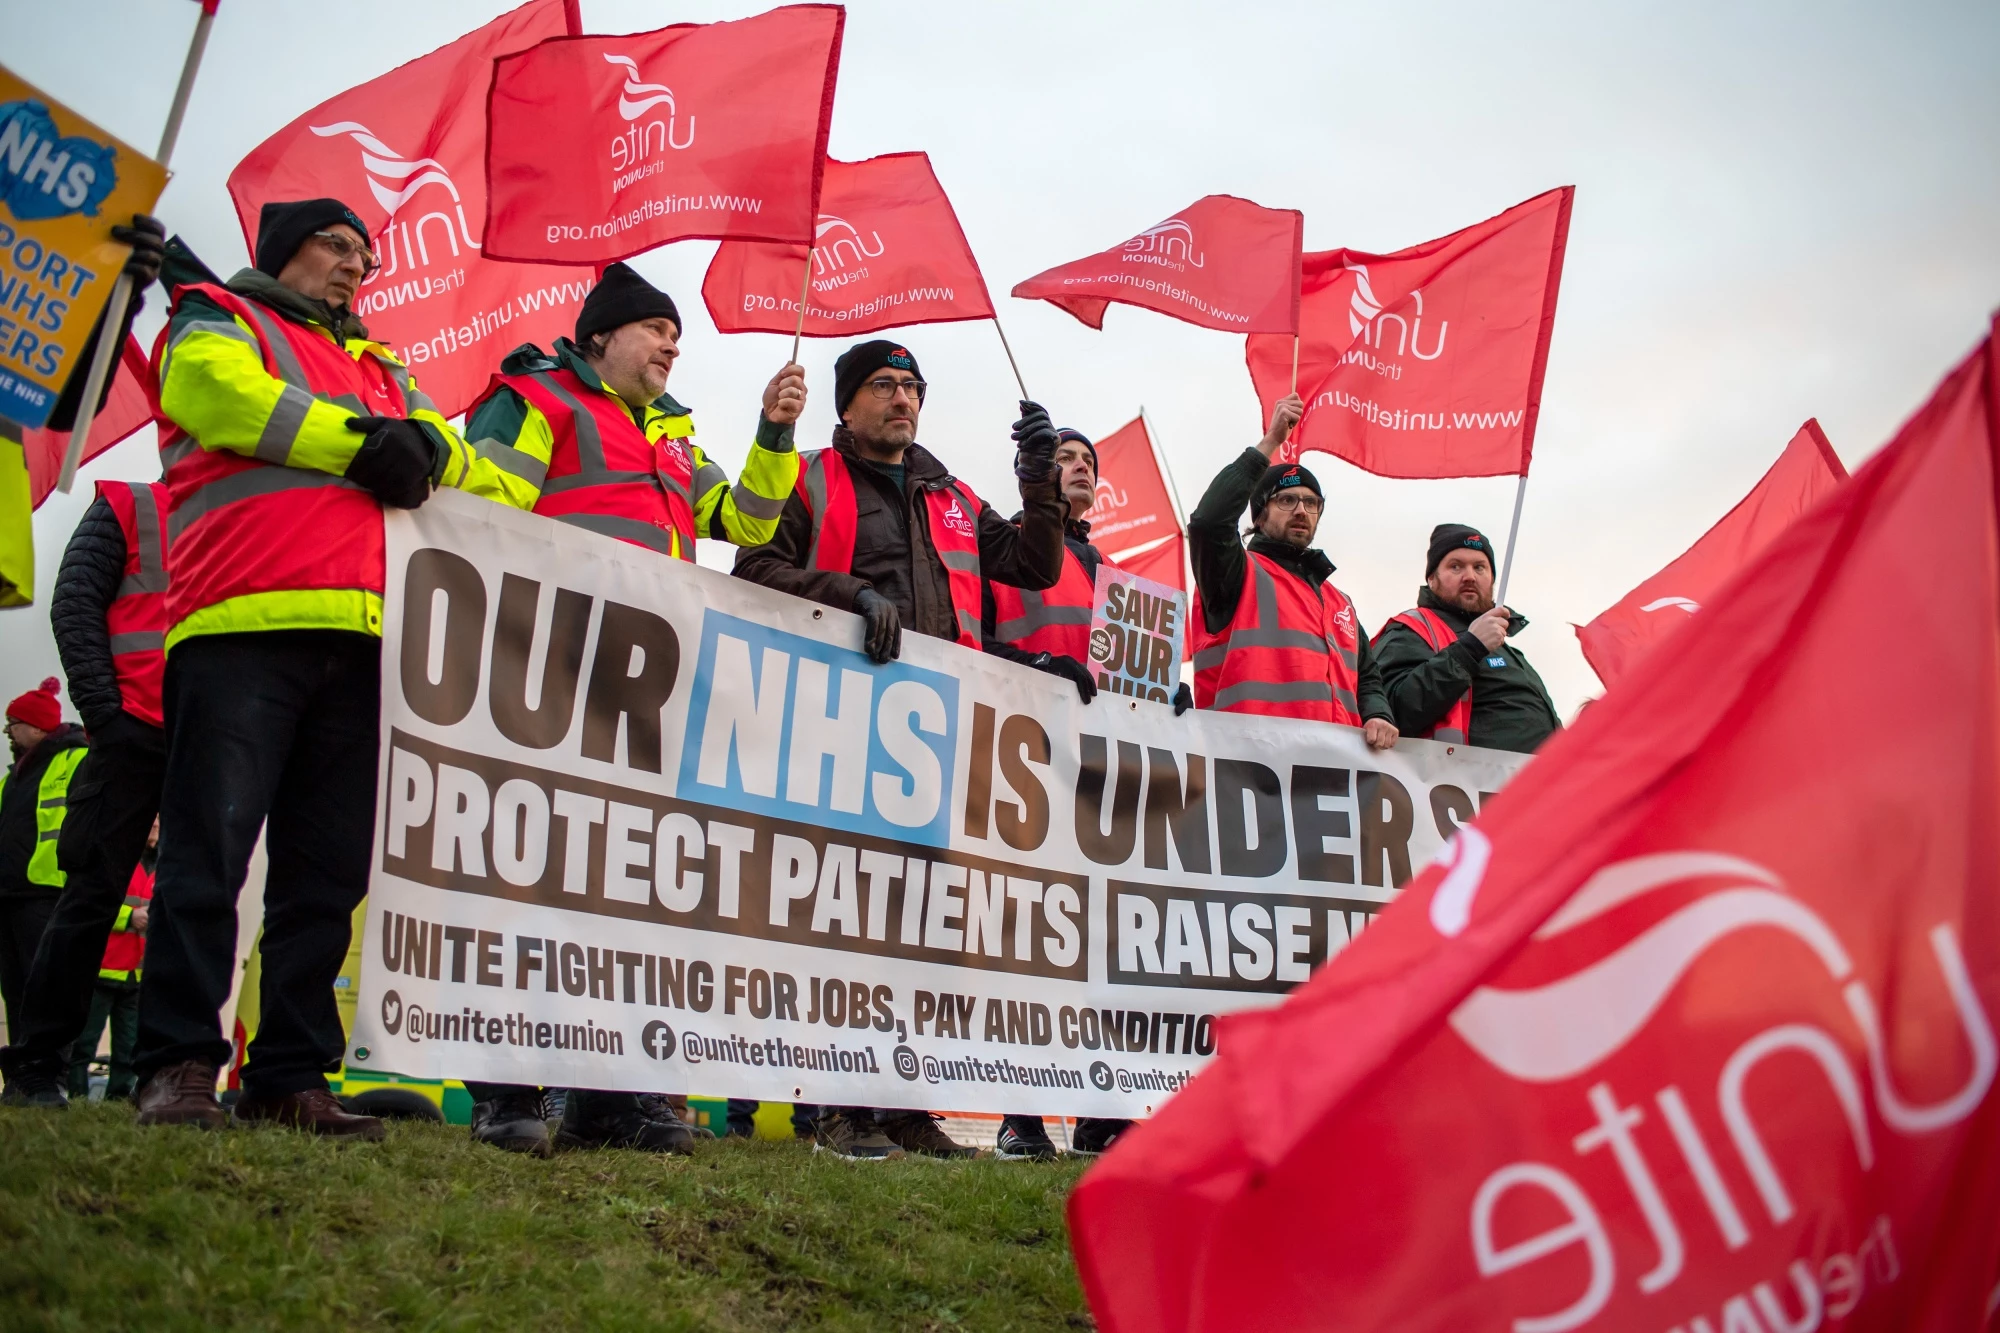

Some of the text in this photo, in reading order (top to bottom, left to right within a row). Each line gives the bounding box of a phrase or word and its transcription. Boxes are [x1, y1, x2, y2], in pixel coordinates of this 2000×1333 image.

[0, 119, 95, 209] NHS
[14, 382, 46, 407] NHS
[1106, 582, 1177, 637] SAVE
[1101, 623, 1173, 687] OUR
[400, 547, 681, 774] OUR
[696, 632, 948, 829] NHS
[964, 701, 1053, 852] IS
[1074, 732, 1416, 890] UNDER
[387, 744, 1082, 968] PROTECT PATIENTS
[1117, 893, 1312, 982] RAISE
[383, 909, 1223, 1057] UNITE FIGHTING FOR JOBS, PAY AND CONDITIO
[406, 1003, 624, 1056] @unitetheunion
[682, 1030, 881, 1075] @unitetheunion1
[922, 1054, 1085, 1090] @unitetheunion
